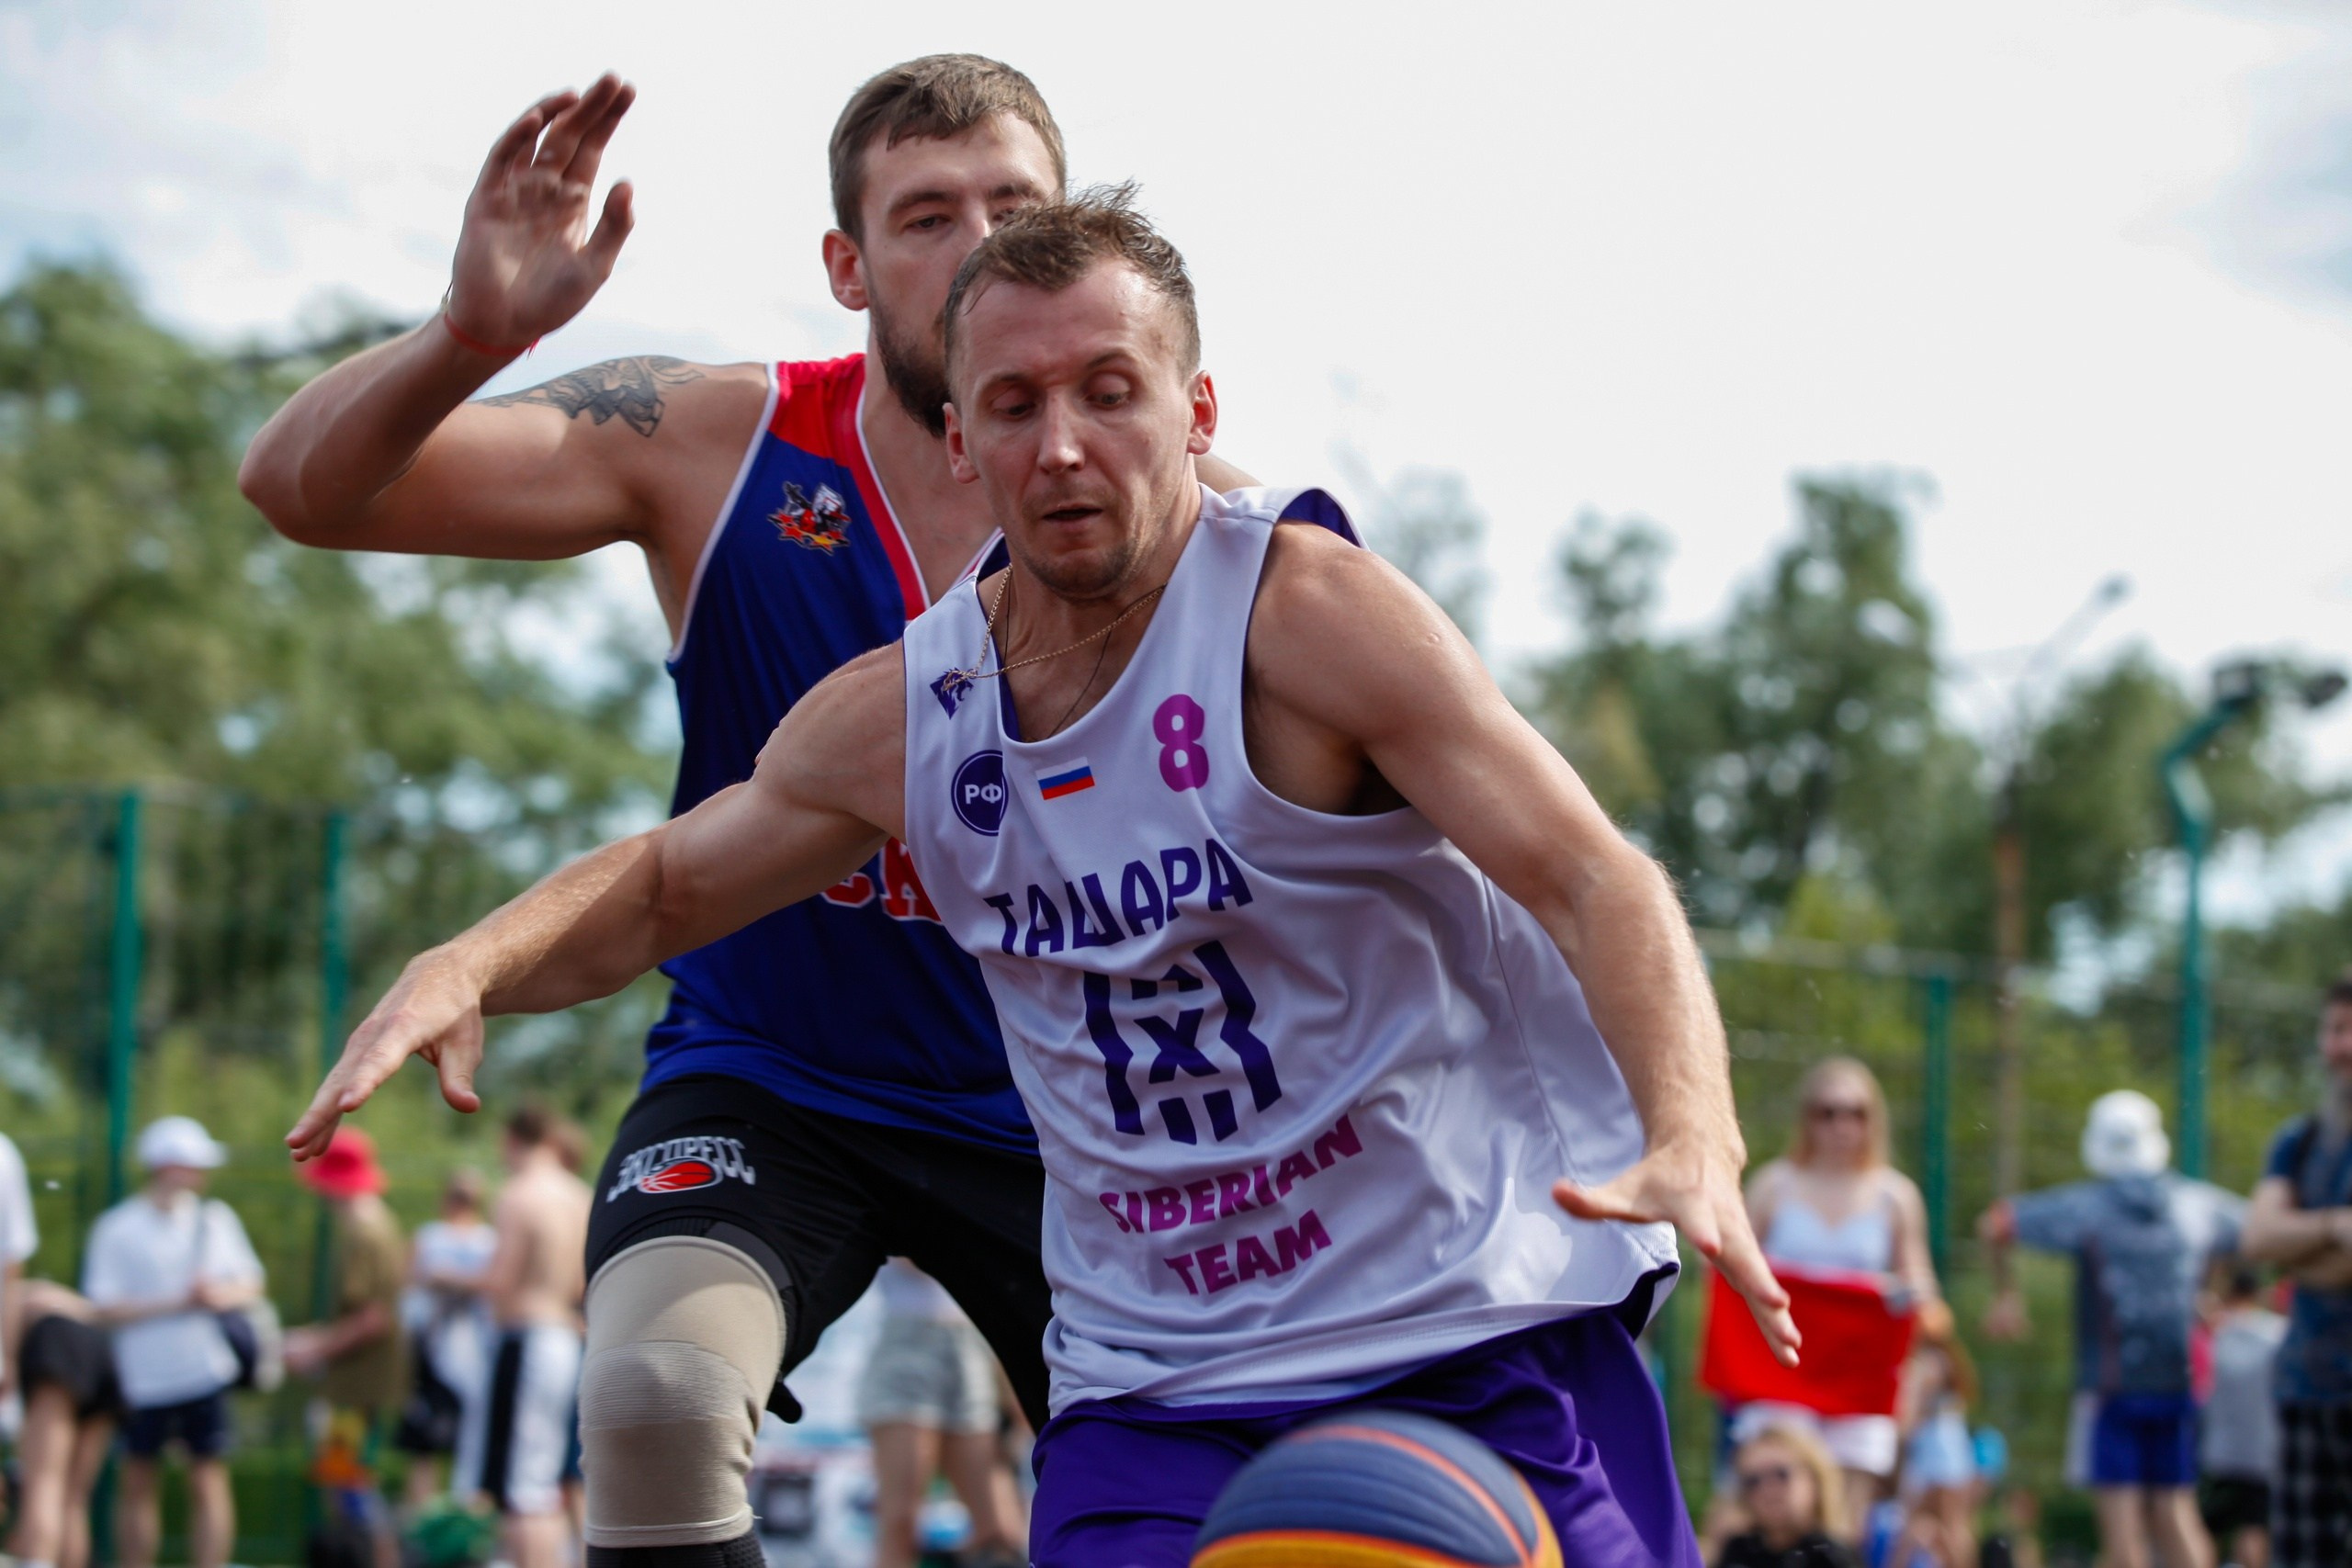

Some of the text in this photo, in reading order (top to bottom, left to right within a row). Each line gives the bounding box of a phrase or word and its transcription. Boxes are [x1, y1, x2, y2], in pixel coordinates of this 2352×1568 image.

[1153, 694, 1210, 793] 8
[964, 783, 1002, 805] РФ
[1099, 1112, 1363, 1234] SIBERIAN
[1163, 1208, 1332, 1296] TEAM
